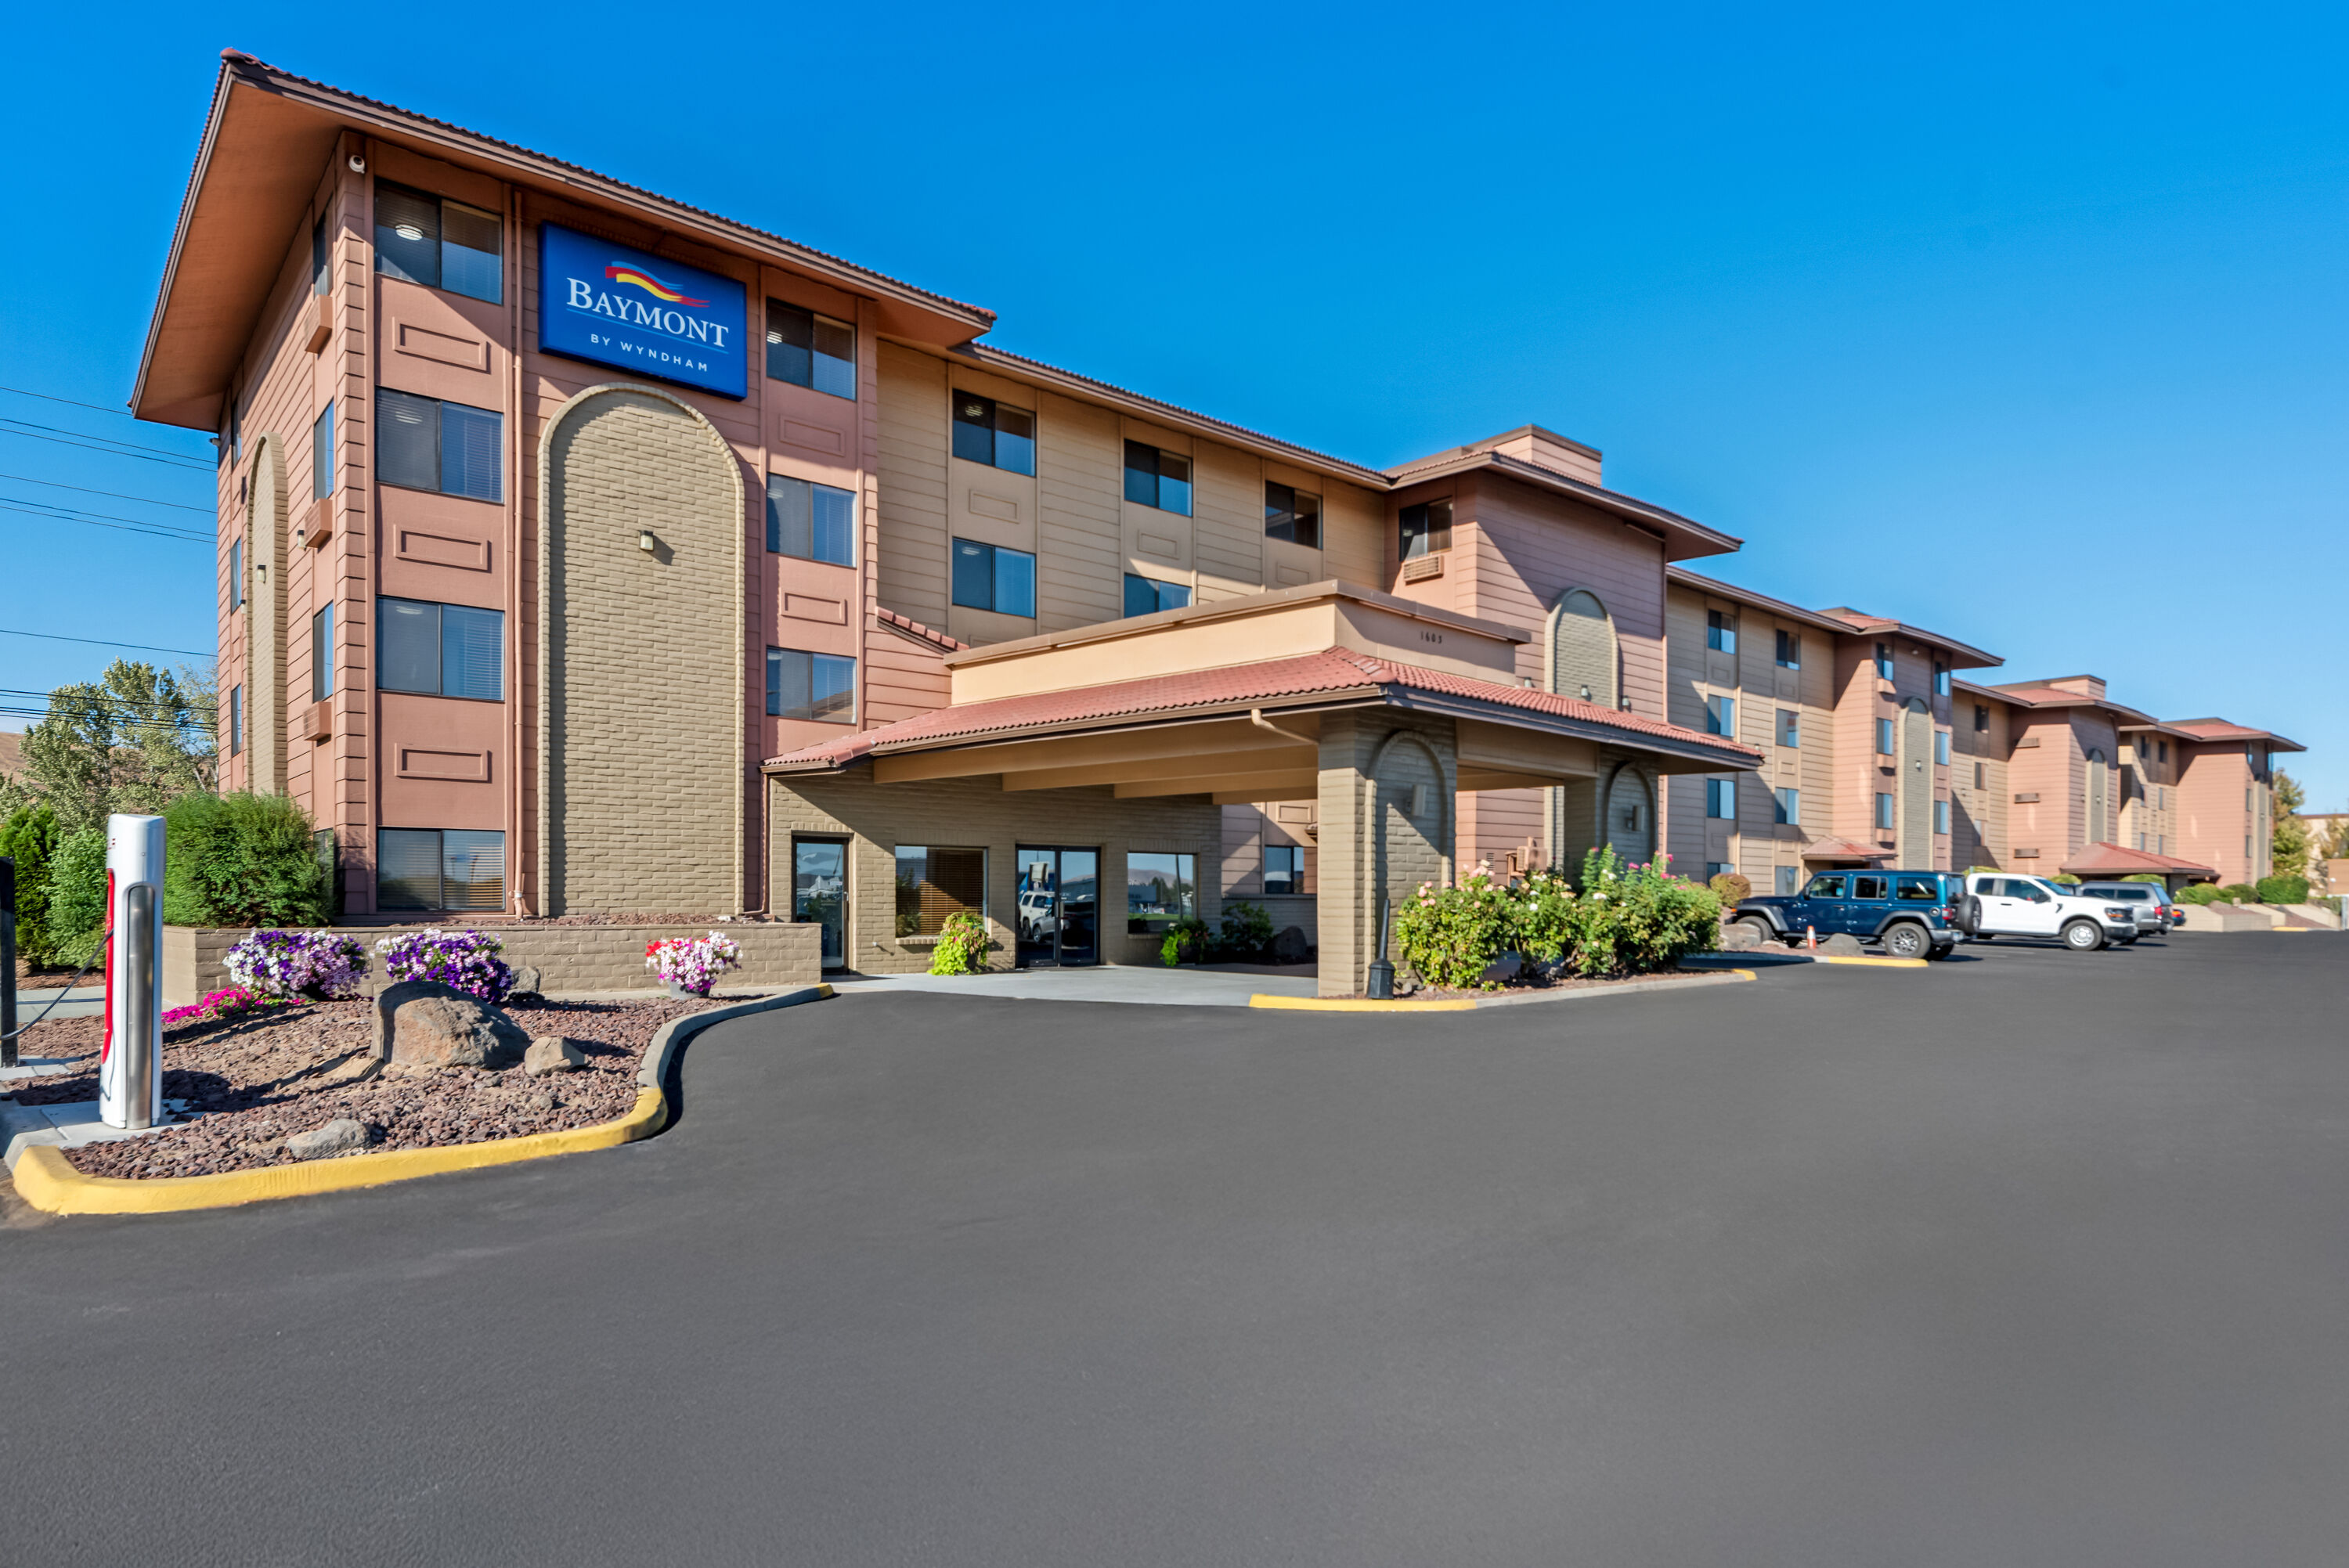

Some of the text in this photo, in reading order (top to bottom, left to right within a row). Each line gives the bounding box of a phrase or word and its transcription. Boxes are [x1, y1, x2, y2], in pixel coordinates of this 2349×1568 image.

[566, 277, 729, 348] BAYMONT
[590, 333, 708, 372] BY WYNDHAM
